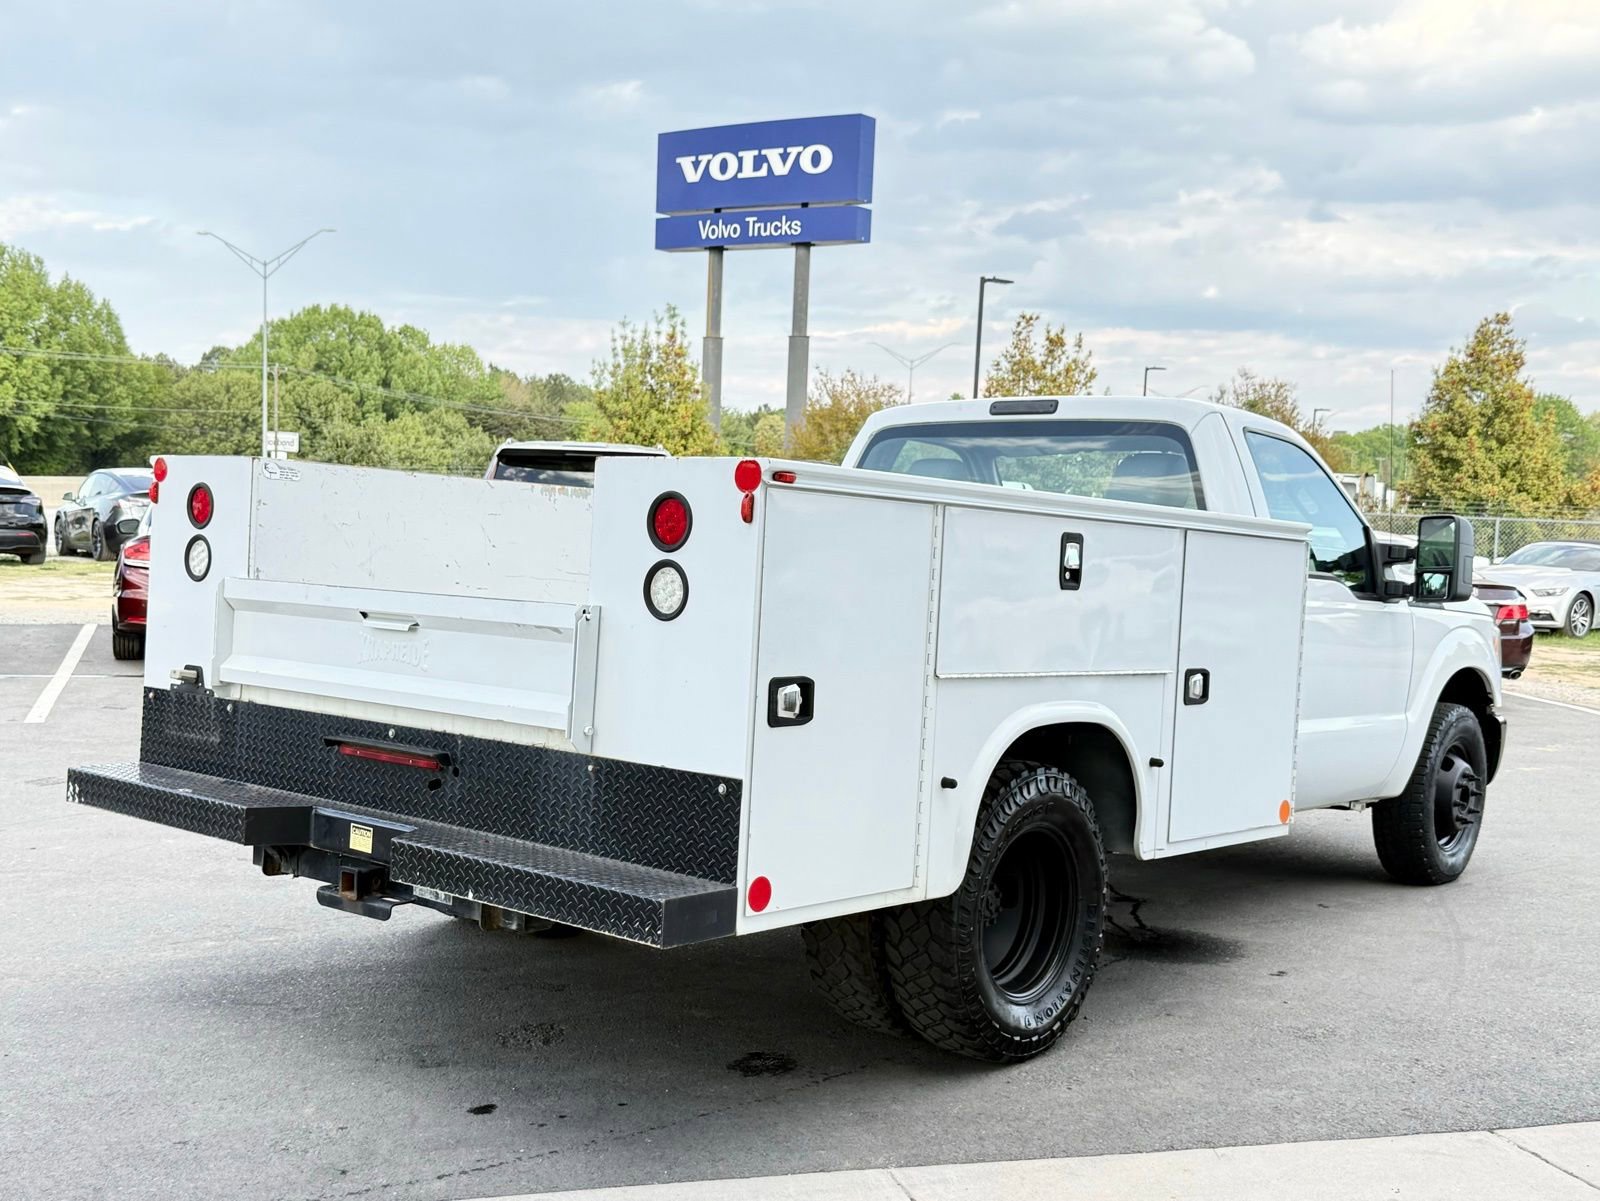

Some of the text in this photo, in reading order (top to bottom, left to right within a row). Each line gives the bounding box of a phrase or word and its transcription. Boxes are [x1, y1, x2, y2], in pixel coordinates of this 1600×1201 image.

[676, 144, 833, 183] VOLVO
[698, 215, 802, 240] Volvo Trucks
[352, 827, 372, 839] CAUTION
